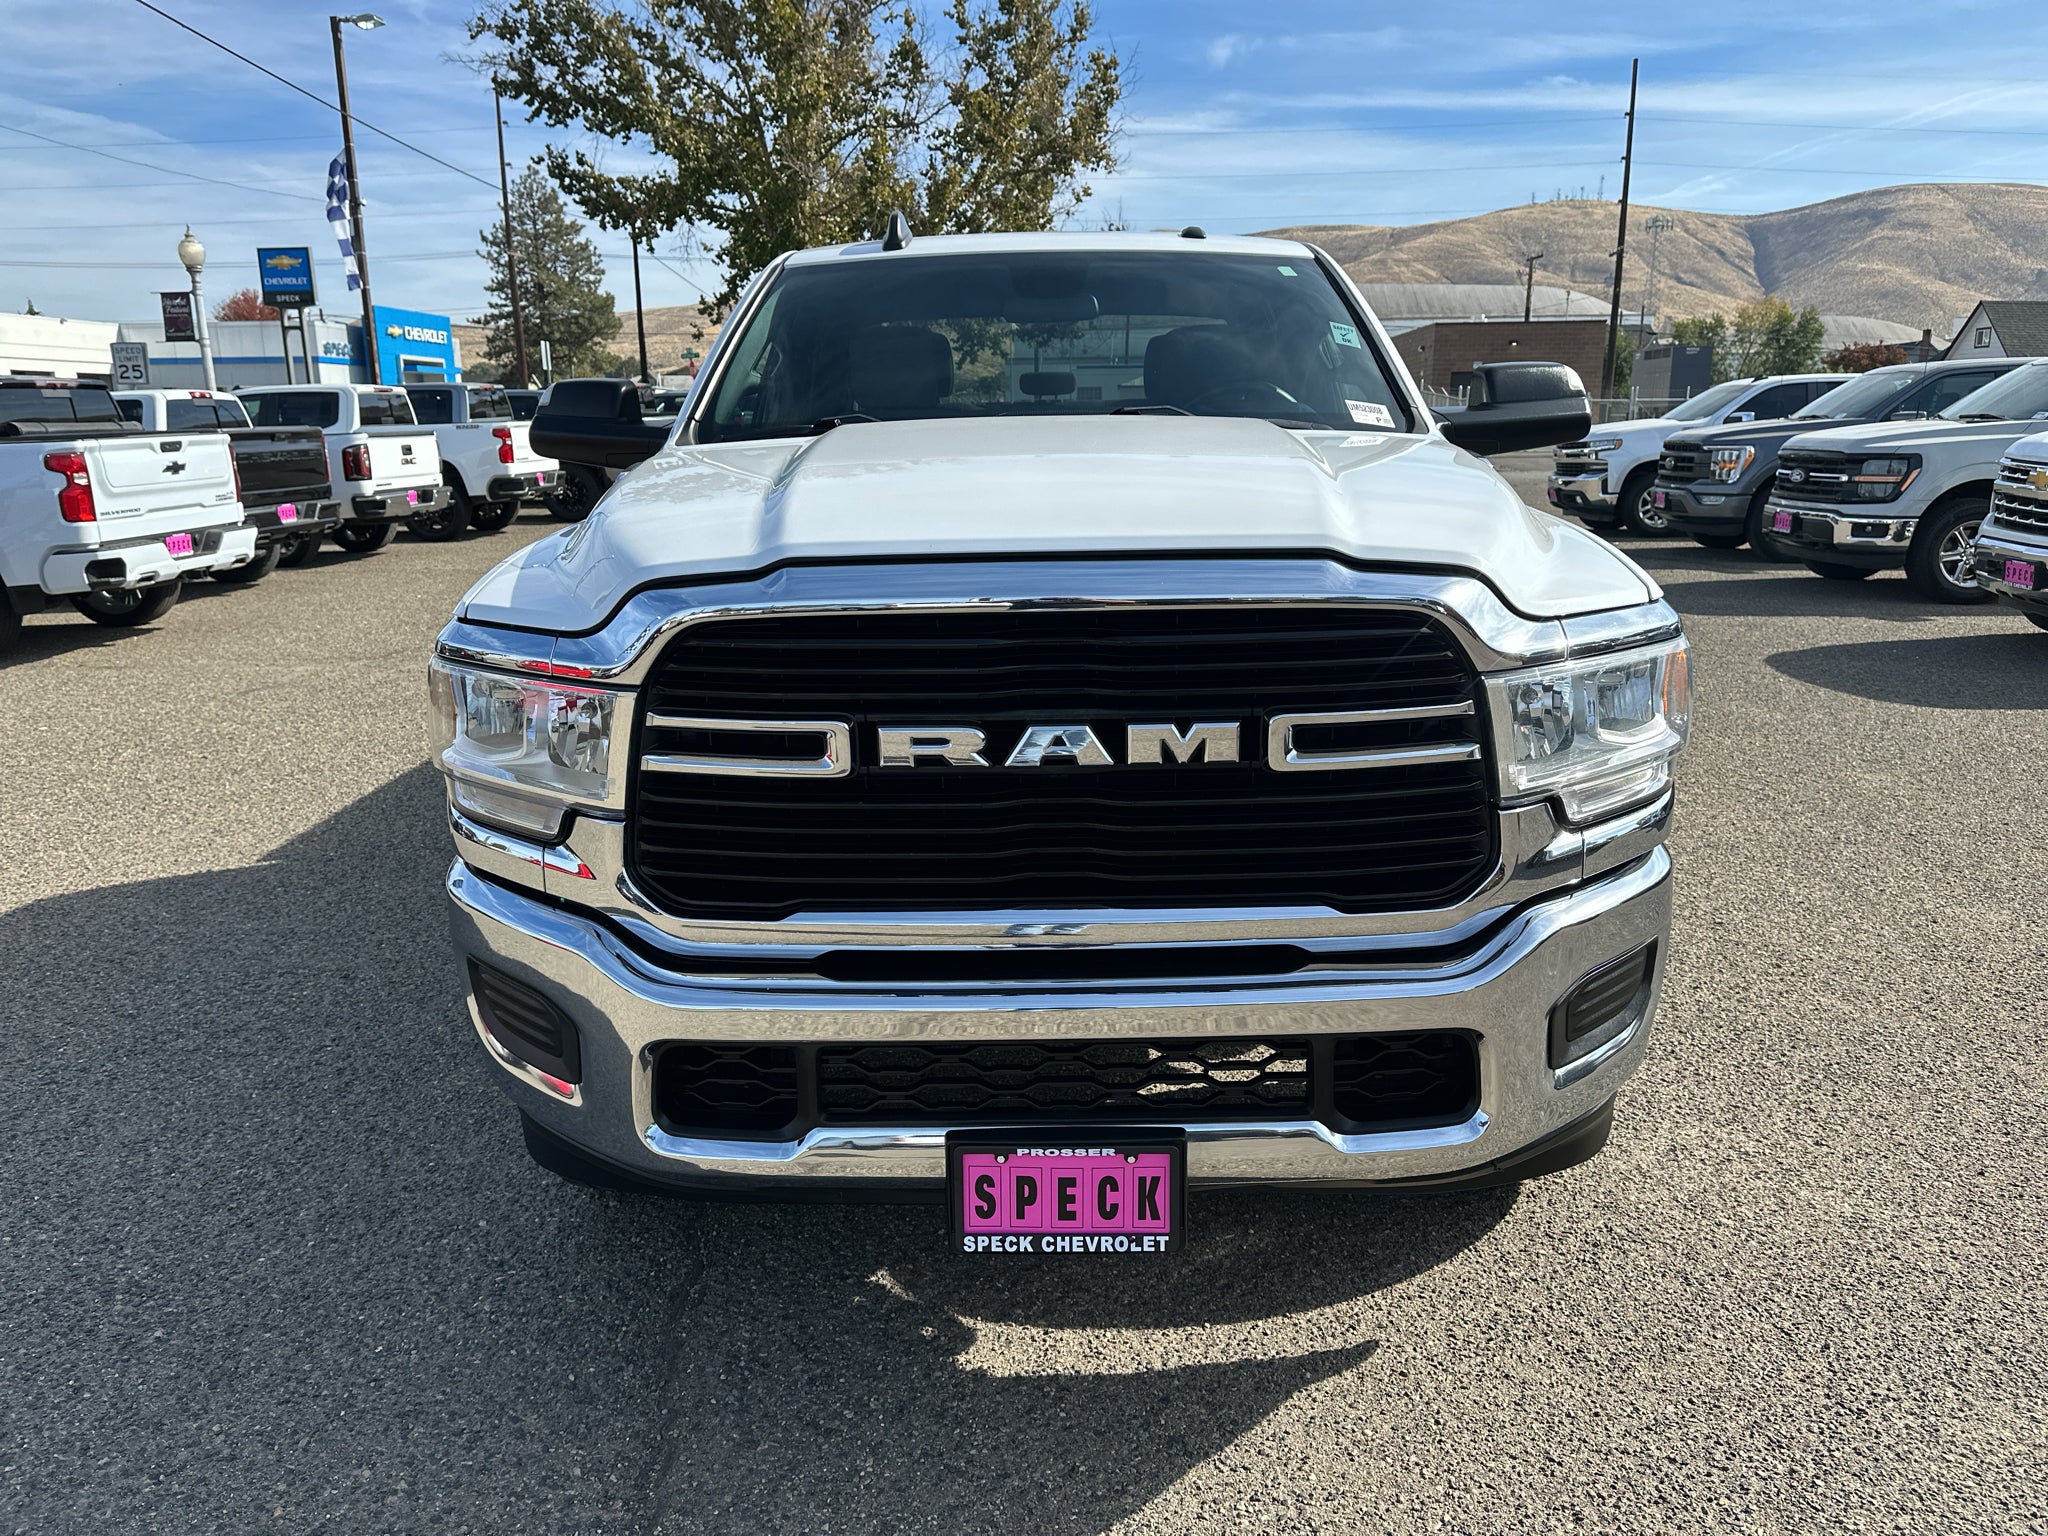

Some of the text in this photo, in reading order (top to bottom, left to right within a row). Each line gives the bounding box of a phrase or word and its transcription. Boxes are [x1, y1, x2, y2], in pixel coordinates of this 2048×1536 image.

[264, 277, 307, 285] CHEVROLET
[276, 294, 300, 302] SPECK
[404, 325, 447, 344] CHEVROLET
[114, 346, 142, 354] SPEED
[118, 355, 139, 363] LIMIT
[118, 364, 143, 379] 25
[401, 457, 417, 465] GMC
[167, 539, 192, 553] SPECK
[878, 721, 1241, 768] RAM
[1016, 1148, 1117, 1157] PROSSER
[974, 1174, 1162, 1222] SPECK
[963, 1235, 1169, 1252] SPECK CHEVROLET
